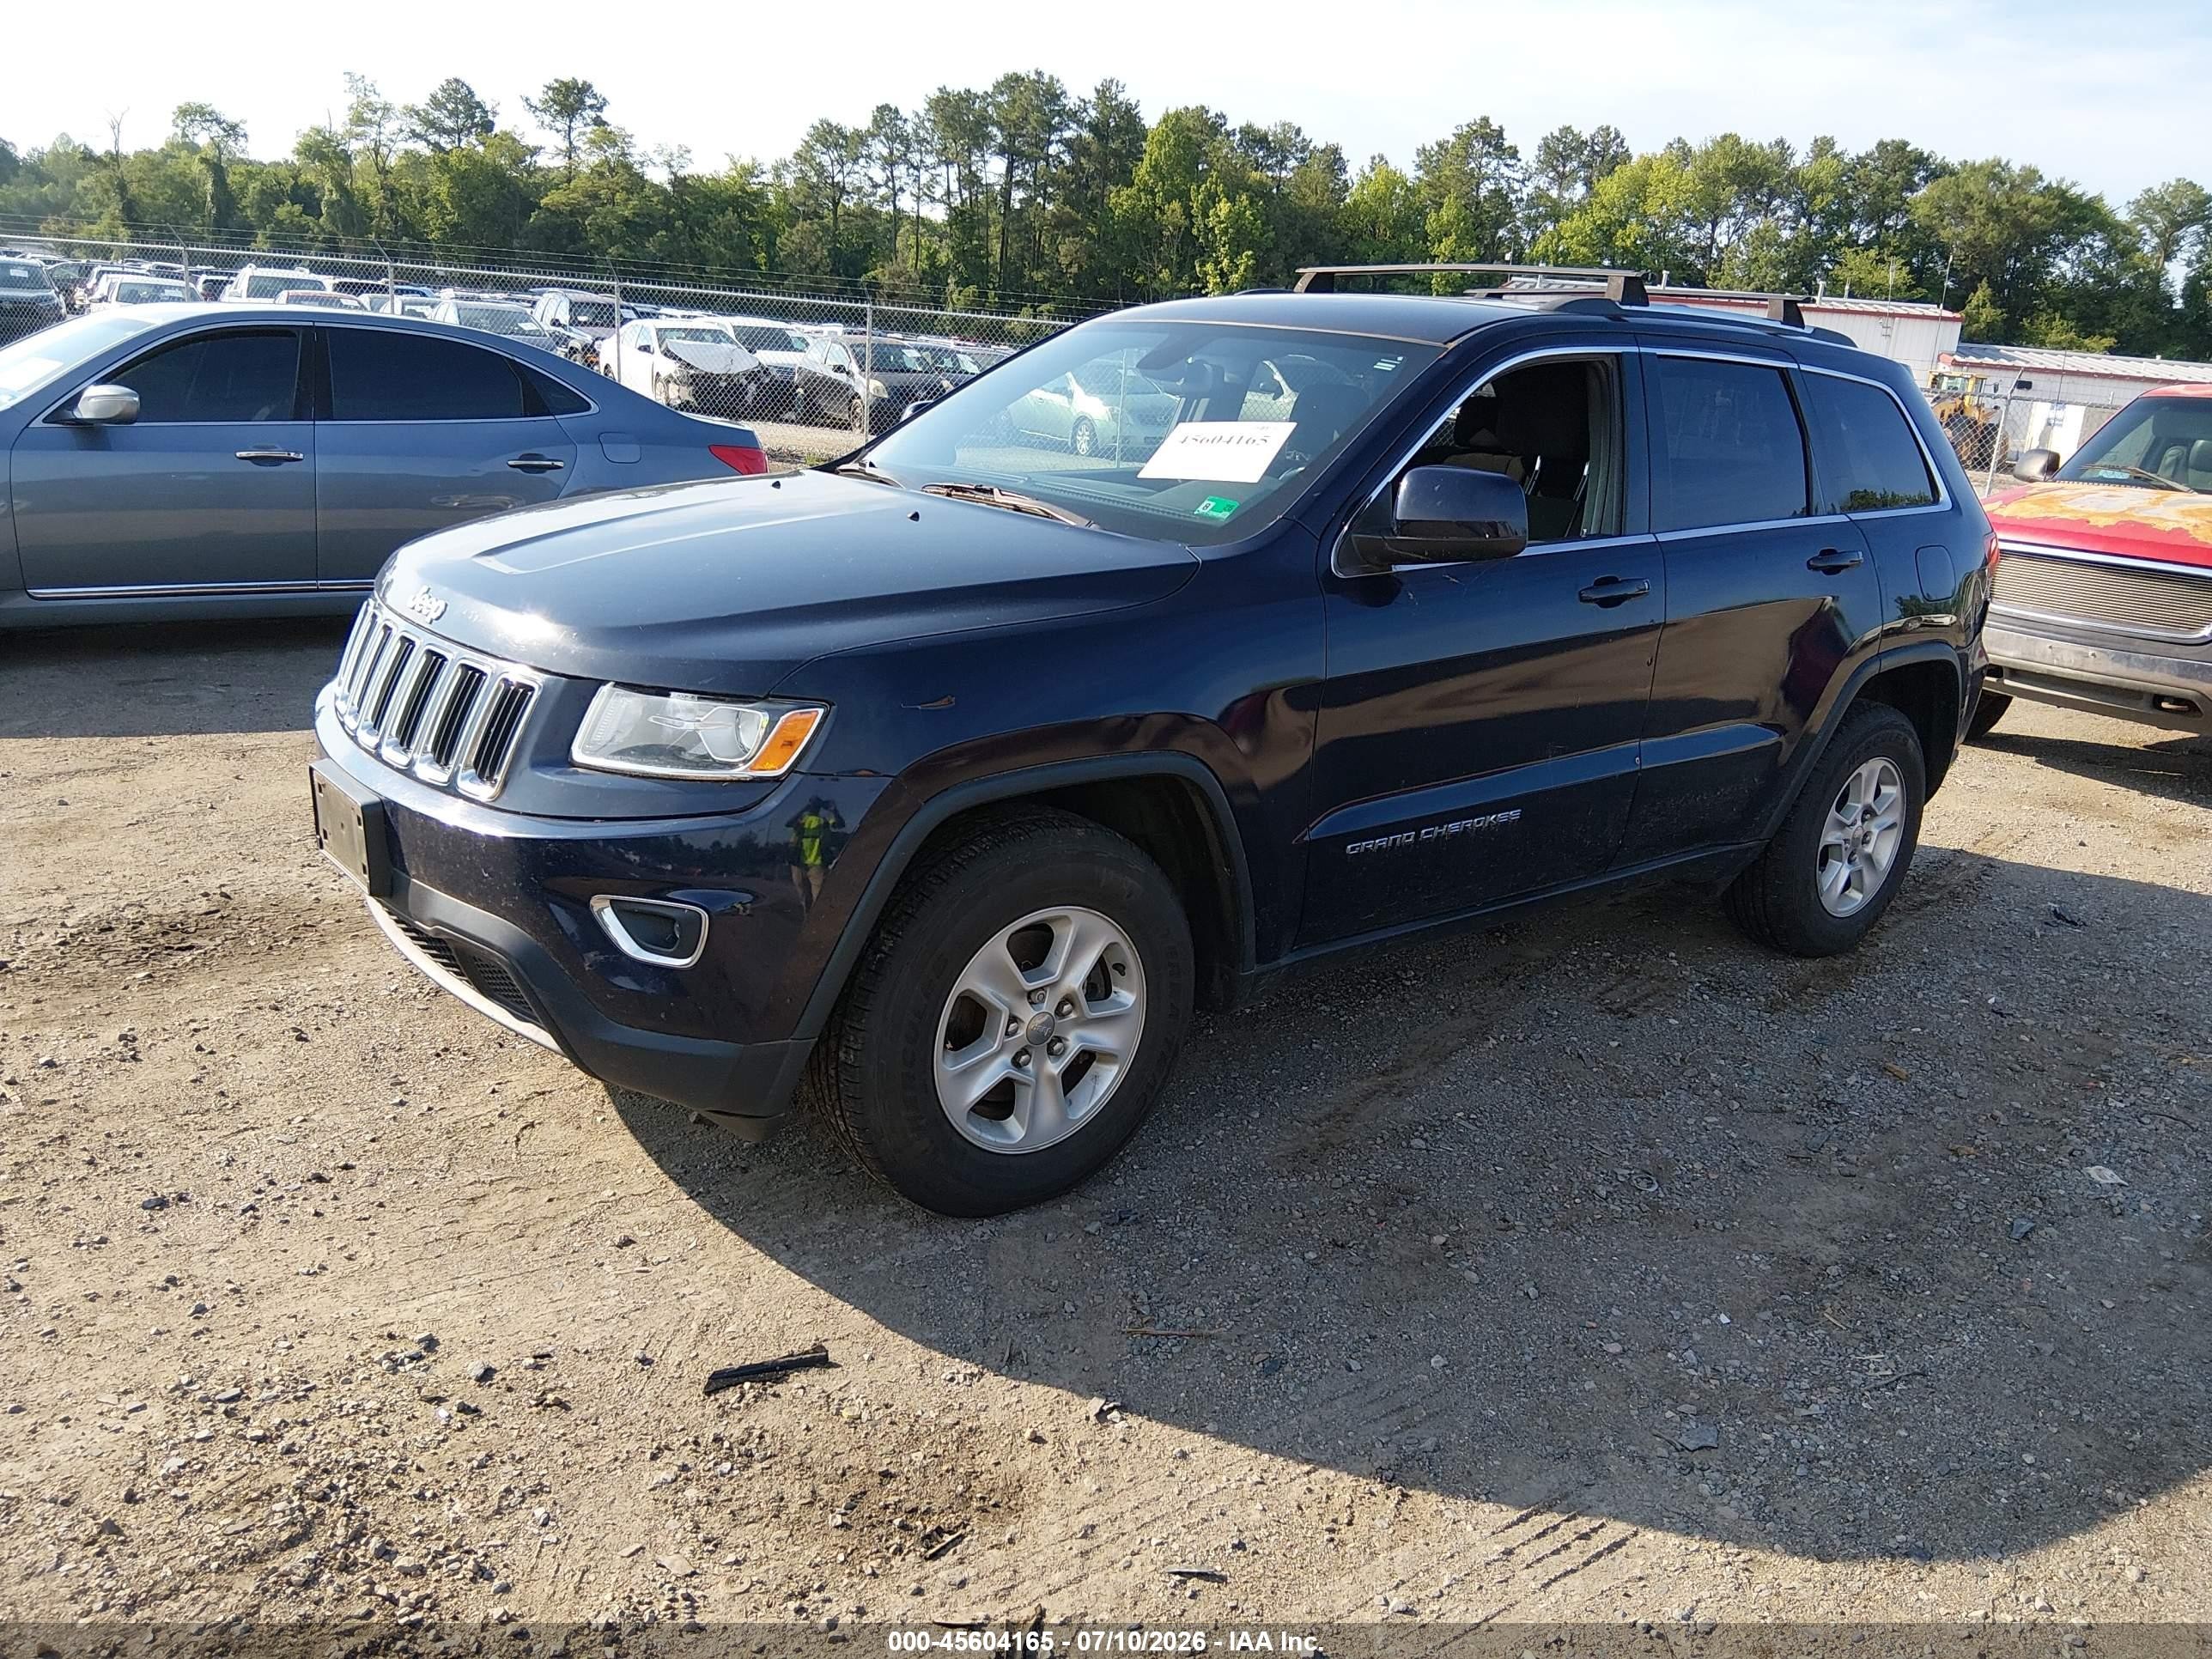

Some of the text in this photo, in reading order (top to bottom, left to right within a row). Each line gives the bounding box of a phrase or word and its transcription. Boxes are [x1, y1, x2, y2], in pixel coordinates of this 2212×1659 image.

[406, 585, 448, 625] Jeep
[1346, 809, 1522, 855] GRAND CHEROKEE
